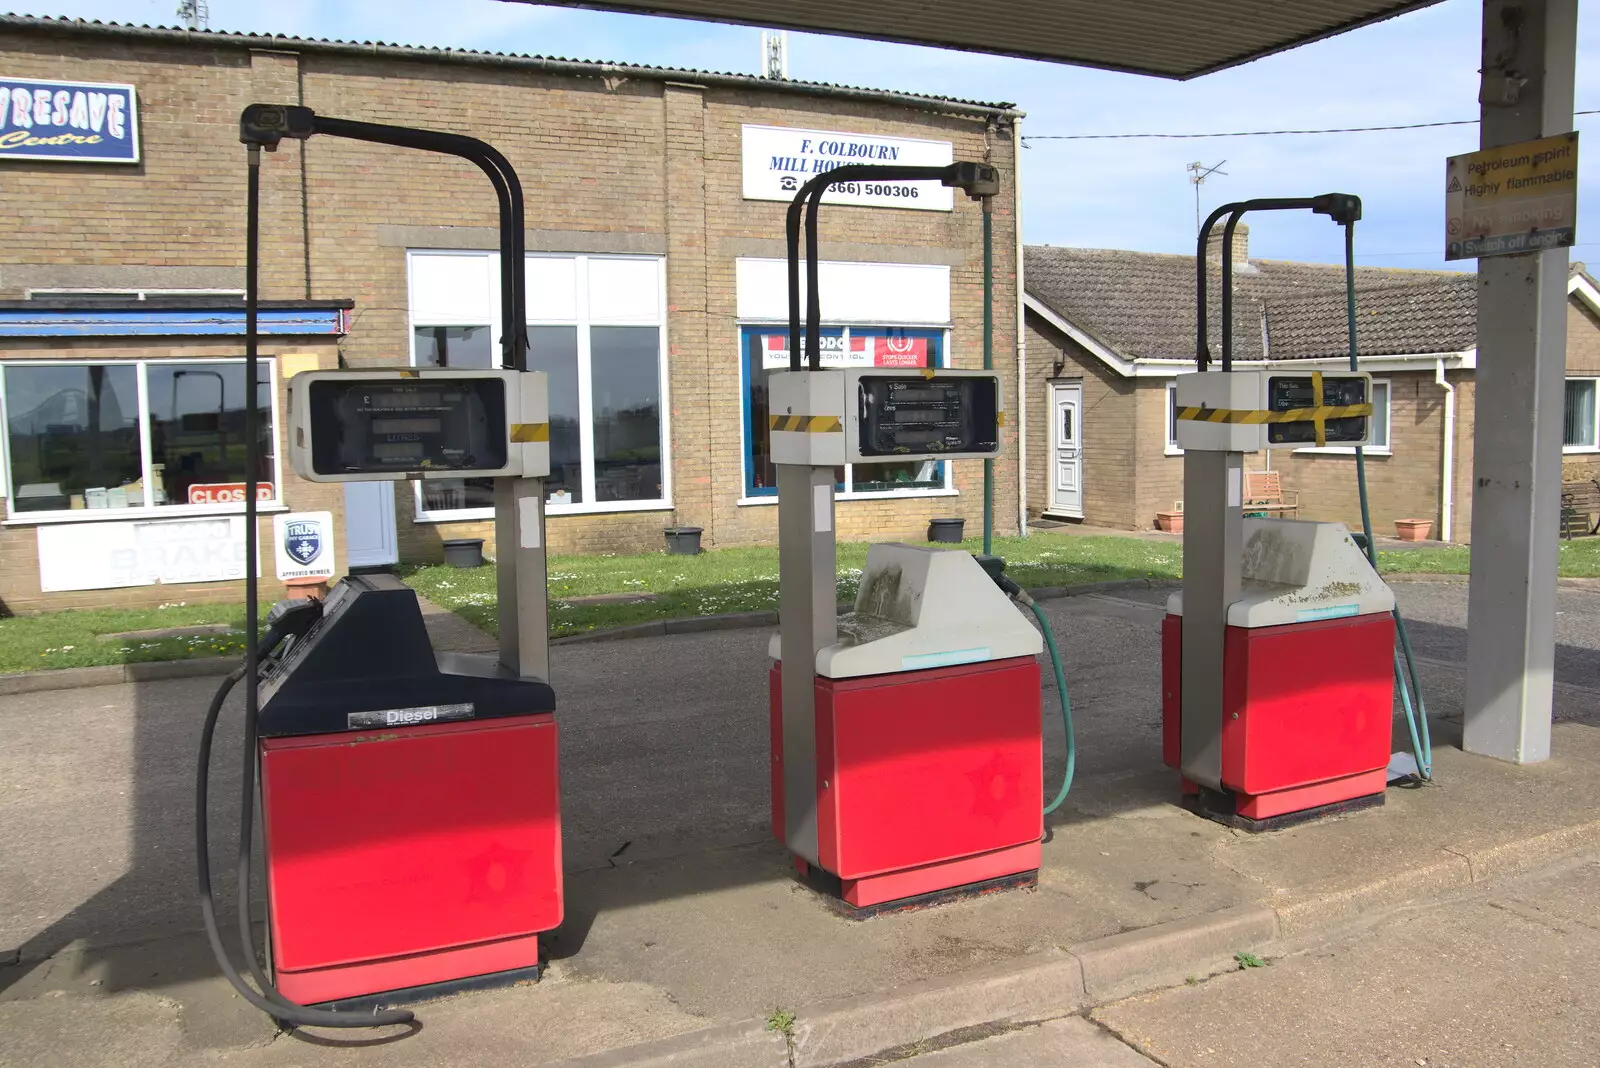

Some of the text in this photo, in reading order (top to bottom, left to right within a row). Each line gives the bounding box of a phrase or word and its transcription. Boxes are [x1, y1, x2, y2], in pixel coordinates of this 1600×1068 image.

[0, 131, 104, 149] Centre
[801, 139, 900, 161] F. COLBOURN
[769, 156, 808, 171] MILL
[1467, 156, 1530, 175] Petroleum
[865, 183, 919, 198] 500306
[1464, 169, 1574, 197] Highly flammable
[1465, 239, 1505, 254] Switch
[1508, 235, 1525, 248] off
[191, 487, 272, 505] CLOSD
[289, 524, 319, 536] TRUST
[108, 563, 243, 584] SPECIALIS
[386, 707, 437, 723] Diesel
